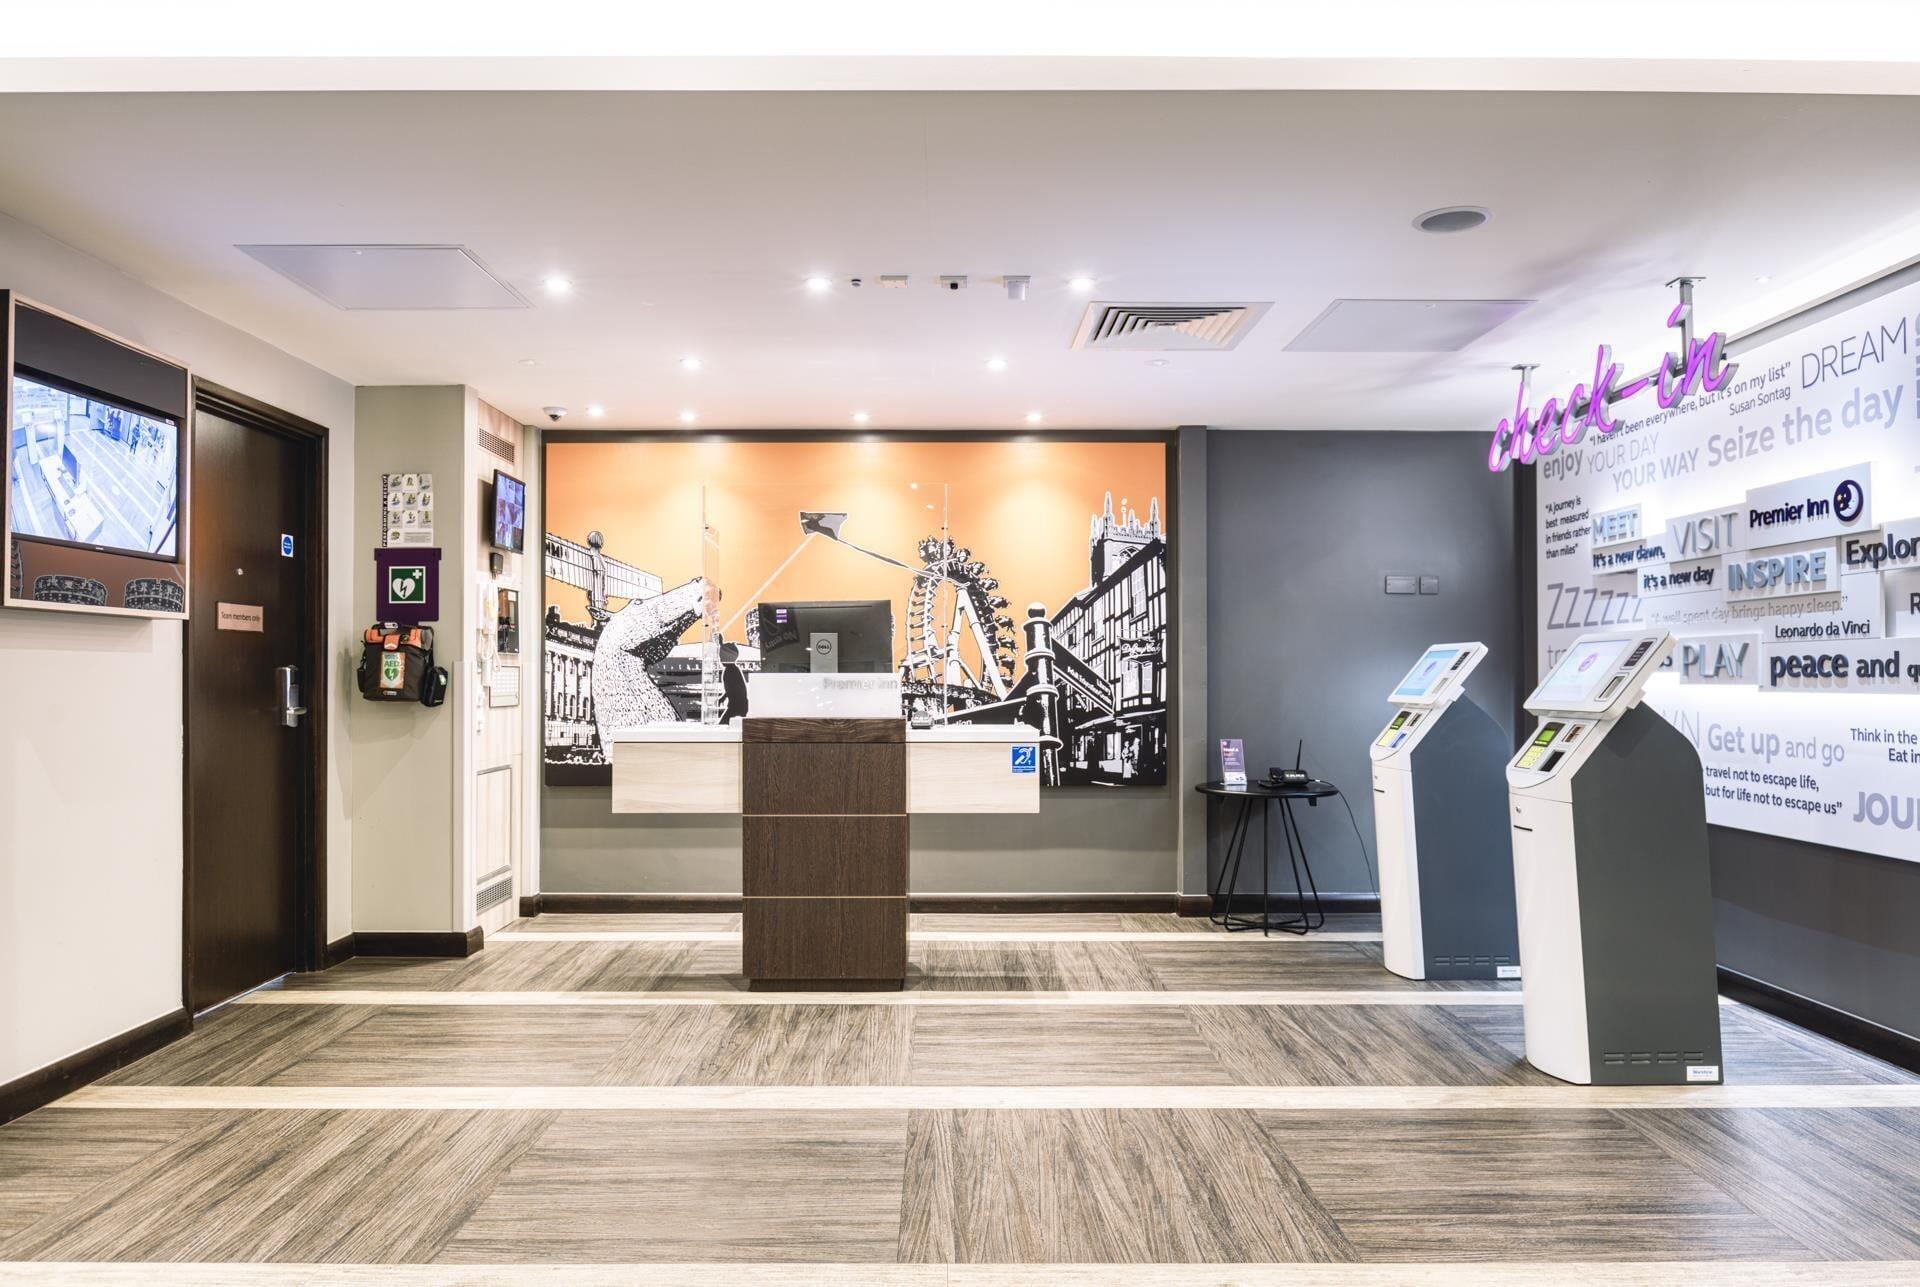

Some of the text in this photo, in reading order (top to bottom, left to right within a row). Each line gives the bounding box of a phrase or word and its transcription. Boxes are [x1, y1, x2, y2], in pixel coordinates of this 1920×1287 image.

[1801, 316, 1907, 389] DREAM
[1488, 302, 1738, 473] check-in
[1729, 386, 1791, 416] Susan Sontag
[1625, 419, 1644, 434] been
[1646, 400, 1698, 427] everywhere,
[1699, 392, 1716, 407] but
[1734, 382, 1747, 394] on
[1750, 375, 1767, 390] my
[1708, 384, 1904, 468] Seize the day
[1543, 432, 1660, 481] enjoy YOUR DAY
[1612, 447, 1700, 493] YOUR WAY
[1545, 509, 1589, 529] best measured
[1552, 500, 1576, 515] journey
[1749, 498, 1830, 529] Premier Inn
[1545, 526, 1592, 544] in friends rather
[1592, 510, 1638, 542] MEET
[1672, 511, 1739, 554] VISIT
[1546, 549, 1559, 559] than
[1607, 555, 1614, 565] a
[1615, 551, 1635, 563] new
[1636, 544, 1666, 561] dawn,
[1845, 533, 1920, 569] Explor
[1660, 574, 1667, 586] a
[1669, 570, 1692, 585] new
[1693, 566, 1715, 585] day
[1728, 551, 1828, 592] INSPIRE
[1683, 608, 1709, 624] spent
[1712, 606, 1730, 624] day
[1731, 604, 1766, 621] brings
[1767, 602, 1805, 618] happy
[1775, 619, 1870, 639] Leonardo da Vinci
[1682, 642, 1749, 678] PLAY
[1769, 653, 1849, 687] peace
[1856, 650, 1900, 678] and
[823, 678, 898, 690] Premier Inn
[1707, 723, 1745, 754] Get
[1750, 731, 1780, 764] up
[1785, 736, 1817, 760] and
[1821, 743, 1845, 767] go
[1850, 727, 1918, 745] Think in the
[1888, 748, 1909, 763] Eat
[1705, 766, 1820, 793] travel not to escape life,
[1705, 784, 1720, 797] but
[1722, 785, 1735, 799] for
[1736, 787, 1751, 801] life
[1753, 792, 1770, 805] not
[1772, 793, 1782, 806] to
[1784, 796, 1822, 814] escape
[1852, 791, 1920, 832] JOU
